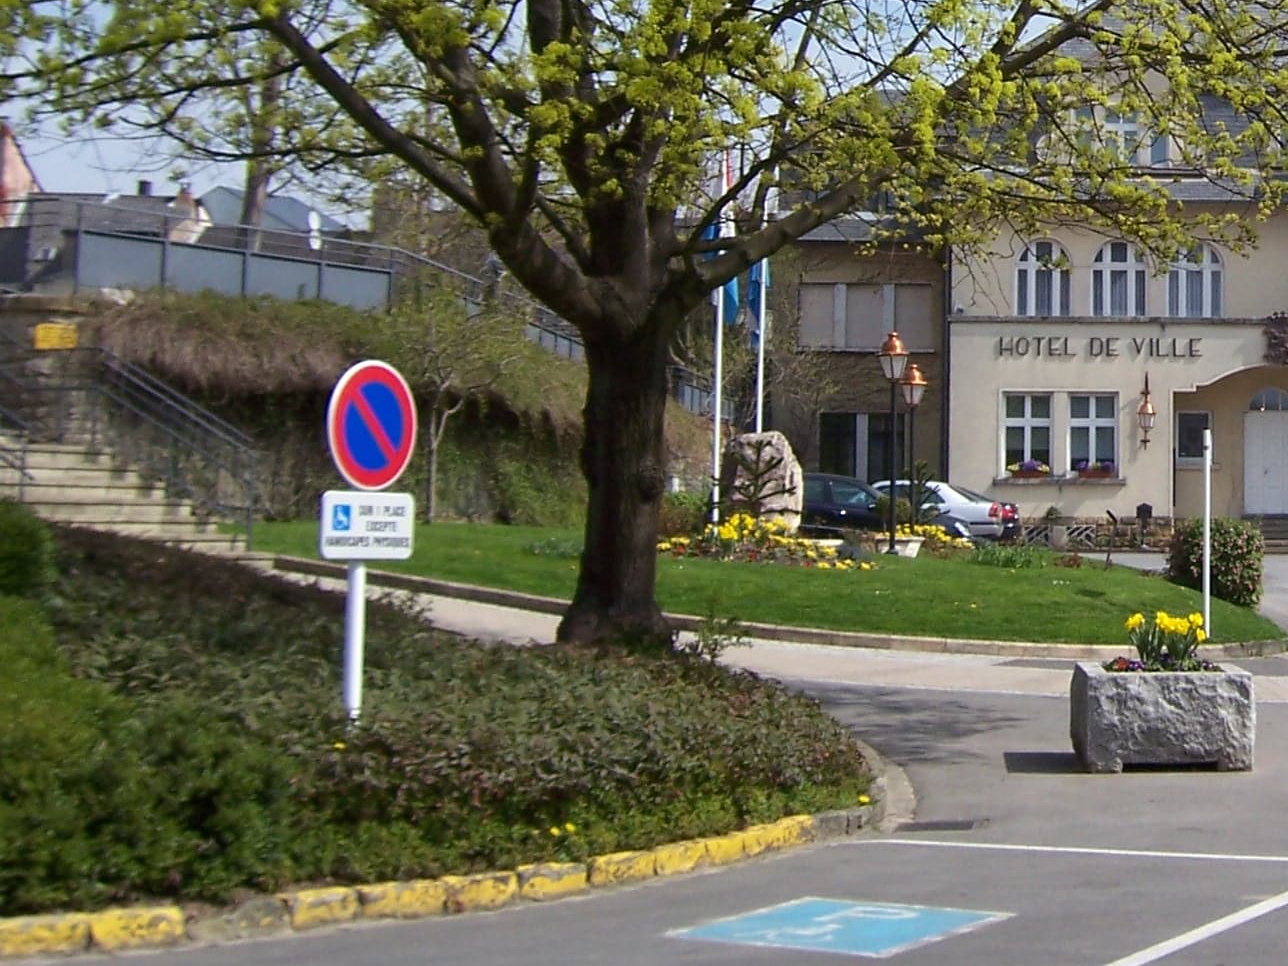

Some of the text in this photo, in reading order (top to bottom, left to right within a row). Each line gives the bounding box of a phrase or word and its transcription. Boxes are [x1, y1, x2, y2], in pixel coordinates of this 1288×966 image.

[998, 336, 1203, 358] HOTEL DE VILLE
[383, 505, 406, 517] PLACE
